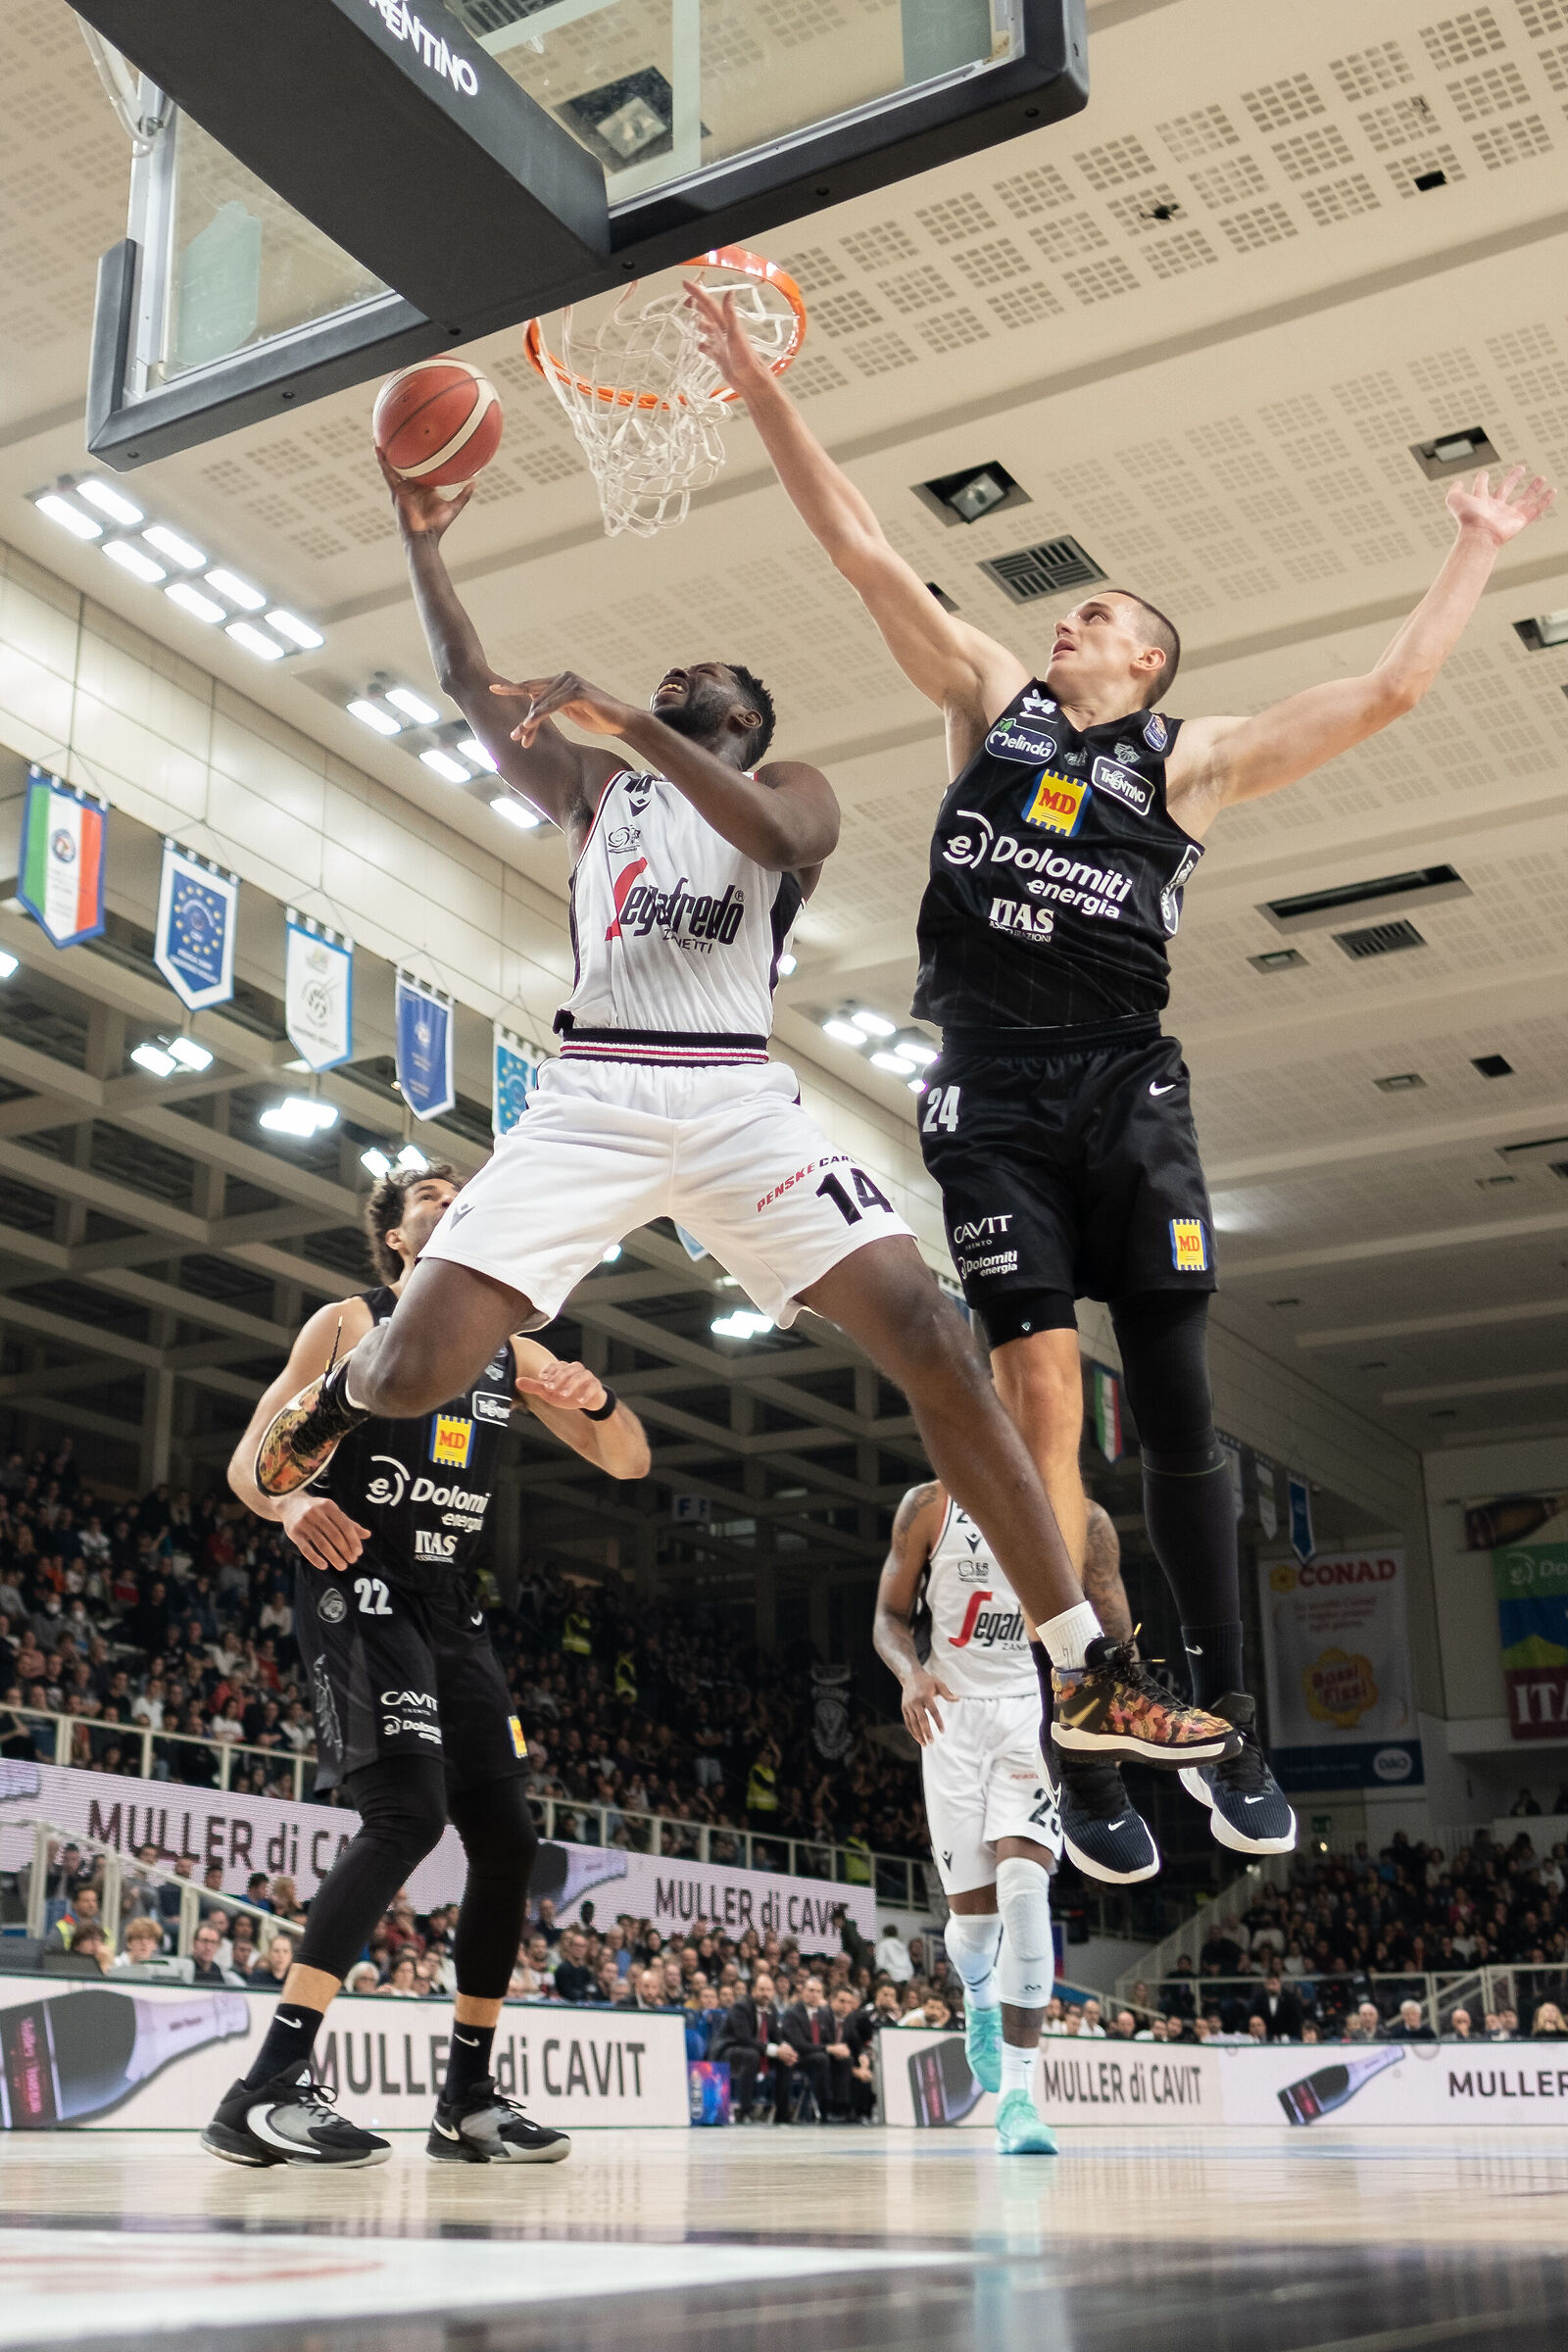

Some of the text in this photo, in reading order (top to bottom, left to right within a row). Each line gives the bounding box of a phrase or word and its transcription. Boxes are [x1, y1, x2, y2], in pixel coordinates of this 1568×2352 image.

[990, 731, 1052, 758] Melinda
[1038, 787, 1076, 816] MD
[1101, 766, 1146, 803] TRENTINO
[990, 836, 1133, 902] Dolomiti
[989, 898, 1054, 934] ITAS
[1027, 879, 1120, 919] energia
[922, 1085, 960, 1133] 24
[757, 1155, 857, 1213] PENSKE CAR
[815, 1168, 895, 1226] 14
[954, 1214, 1013, 1245] CAVIT
[1179, 1235, 1200, 1252] MD
[966, 1250, 1018, 1273] Dolomiti
[981, 1263, 1018, 1277] energia
[439, 1431, 466, 1449] MD
[411, 1477, 492, 1514] Dolomi
[415, 1530, 459, 1556] ITAS
[1298, 1558, 1397, 1588] CONAD
[354, 1578, 393, 1615] 22
[86, 1799, 255, 1871] MULLER
[268, 1822, 298, 1874] di
[655, 1878, 755, 1928] MULLER
[760, 1890, 781, 1930] di
[310, 2031, 450, 2095] MULLE
[497, 2034, 528, 2097] di
[542, 2038, 646, 2098] CAVIT
[1043, 2060, 1201, 2105] MULLER di CAVIT
